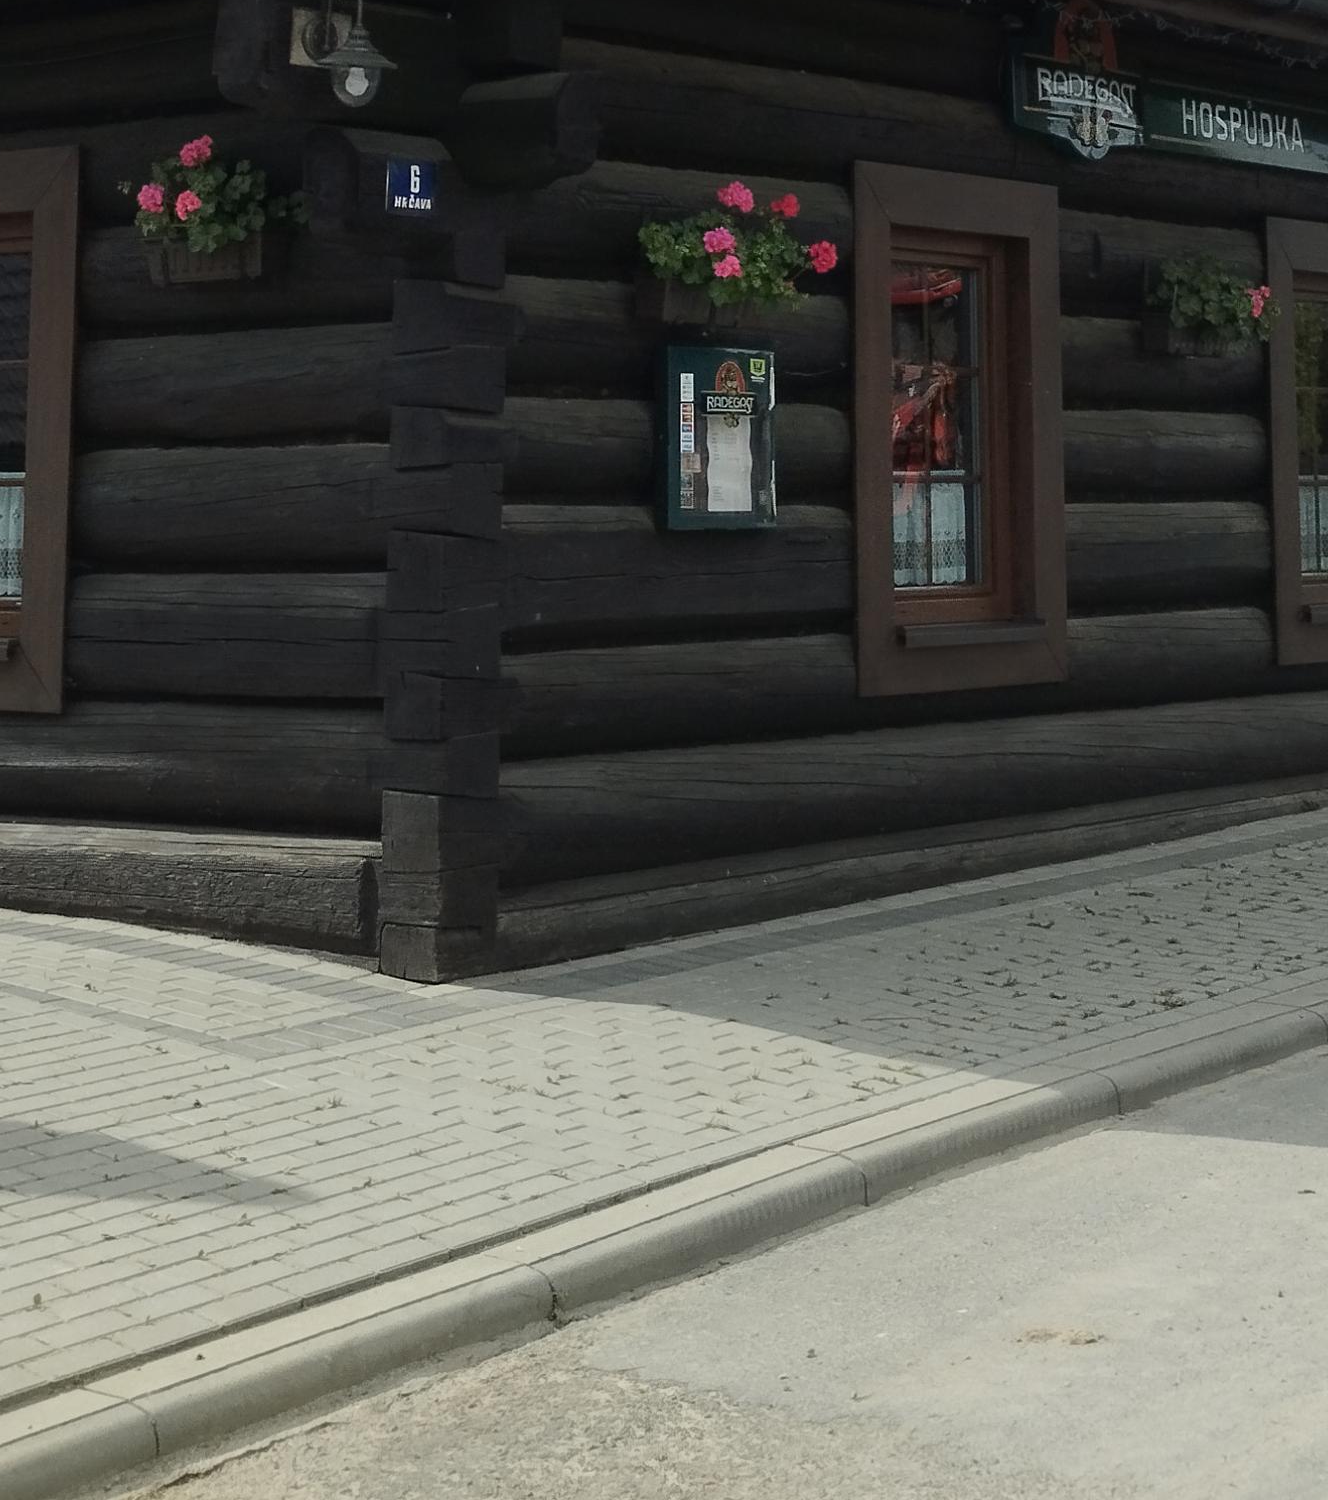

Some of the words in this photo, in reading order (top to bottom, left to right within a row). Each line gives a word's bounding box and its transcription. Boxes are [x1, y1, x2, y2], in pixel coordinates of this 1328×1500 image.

[1036, 67, 1137, 107] RADEGAST
[1182, 99, 1305, 154] HOSPŮDKA
[410, 165, 420, 194] 6
[394, 194, 432, 209] HRČAVA
[706, 395, 755, 413] RADEGAST
